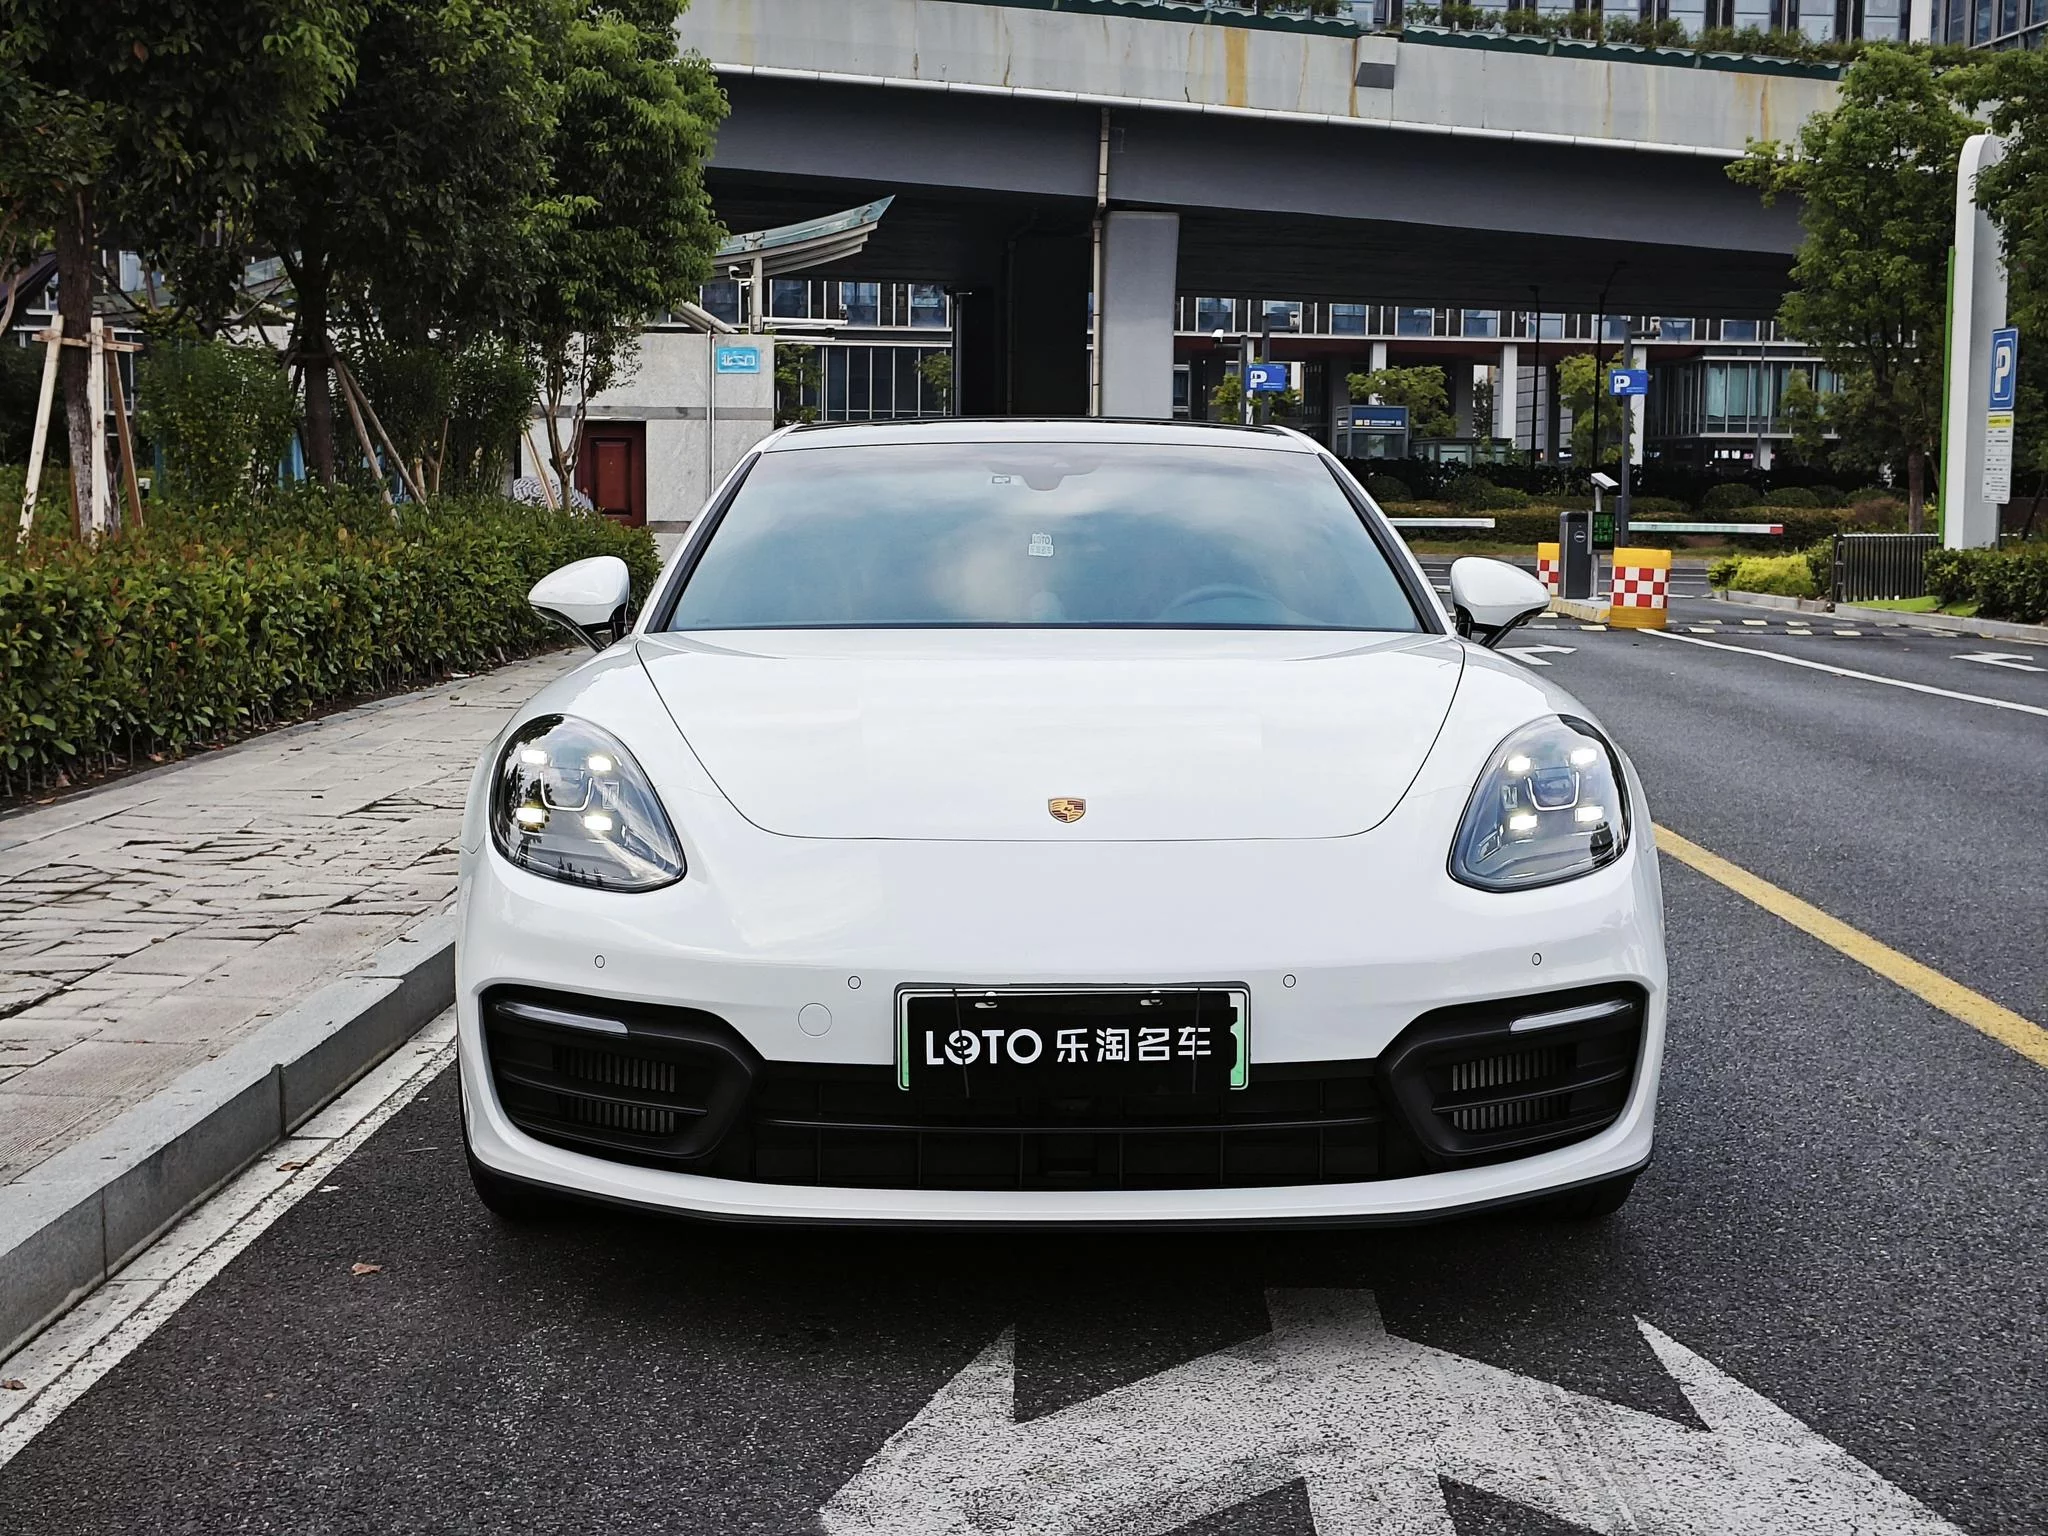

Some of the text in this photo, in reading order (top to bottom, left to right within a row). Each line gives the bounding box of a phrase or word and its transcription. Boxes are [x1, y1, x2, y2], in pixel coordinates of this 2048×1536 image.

[1250, 370, 1268, 388] P
[1613, 375, 1631, 393] P
[1994, 346, 2011, 394] P
[926, 1026, 1212, 1065] LOTO 乐淘名车
